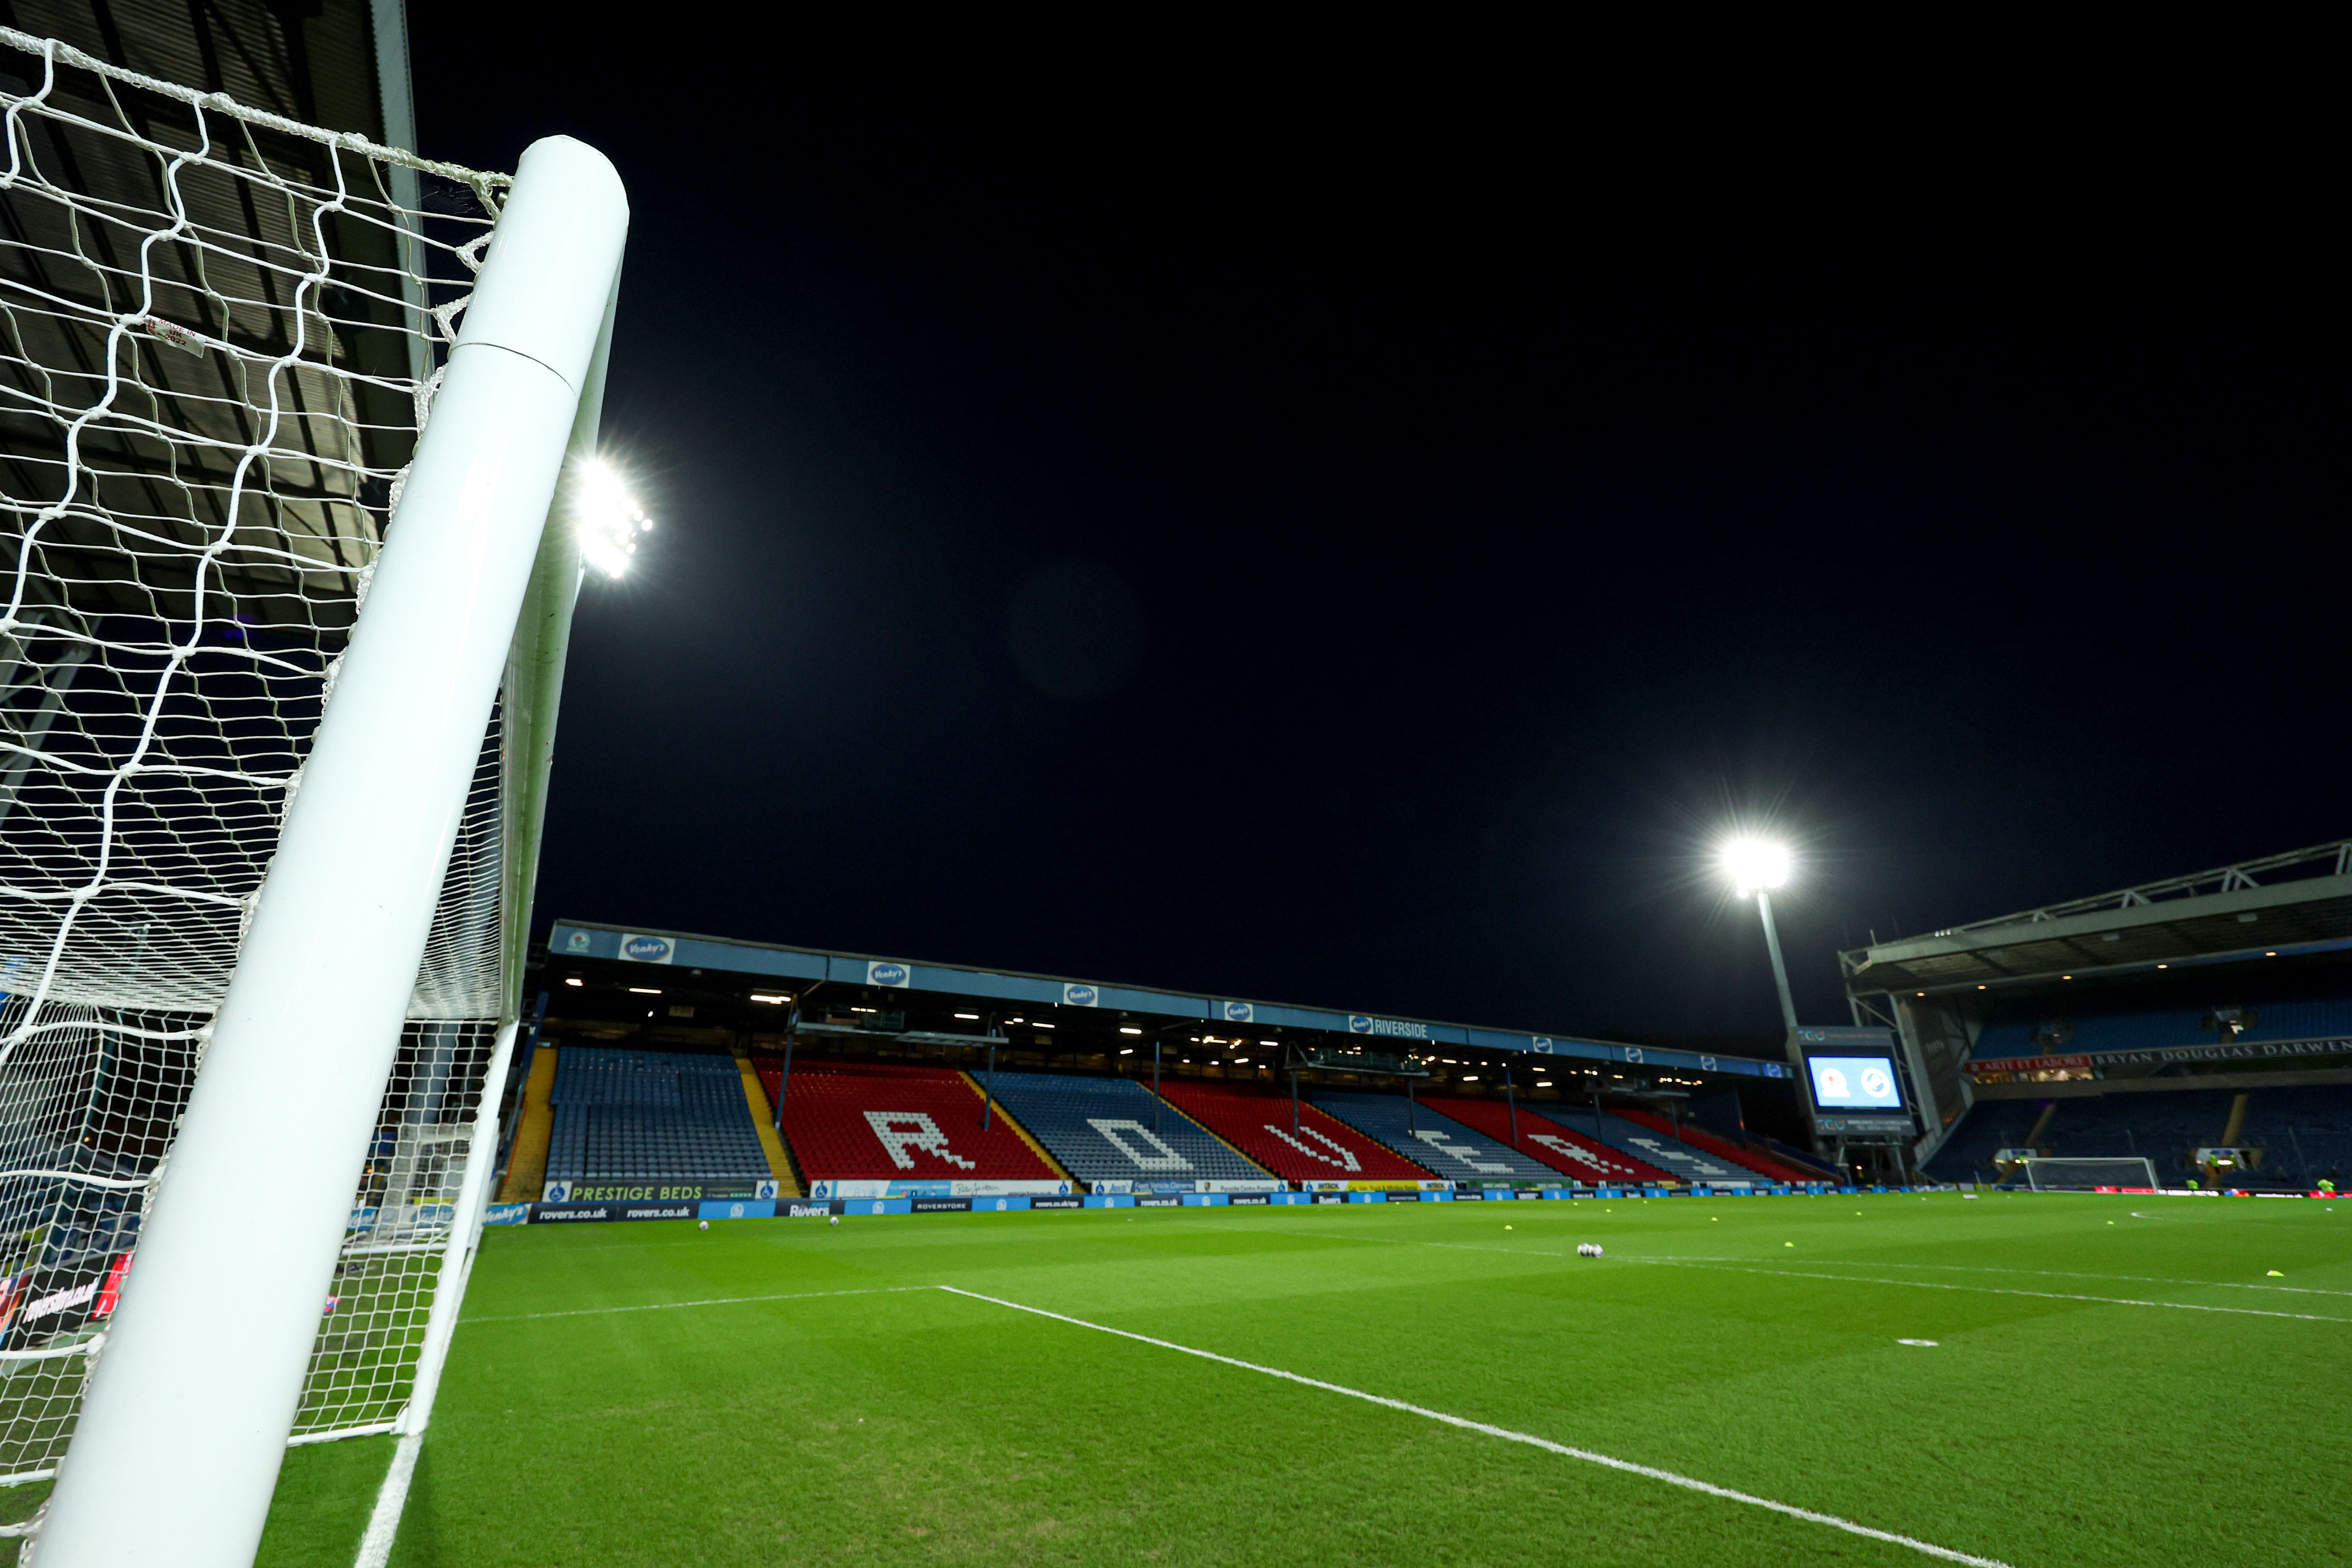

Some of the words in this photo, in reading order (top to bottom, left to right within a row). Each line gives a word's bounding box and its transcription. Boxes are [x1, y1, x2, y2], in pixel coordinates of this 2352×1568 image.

[159, 319, 185, 333] MADE
[165, 334, 187, 346] 2022
[170, 329, 182, 338] UK
[630, 943, 665, 956] Venky's
[874, 969, 903, 980] Venky's
[1069, 990, 1092, 1001] Venky's
[1376, 1019, 1427, 1038] RIVERSIDE
[2095, 1052, 2153, 1065] BRYAN
[2161, 1046, 2254, 1062] DOUGLAS
[2263, 1040, 2352, 1055] DARWEN
[571, 1186, 654, 1201] PRESTIGE
[659, 1186, 702, 1200] BEDS
[539, 1207, 608, 1220] rovers.co.uk
[627, 1206, 690, 1218] rovers.co.uk
[789, 1204, 829, 1217] Rovers
